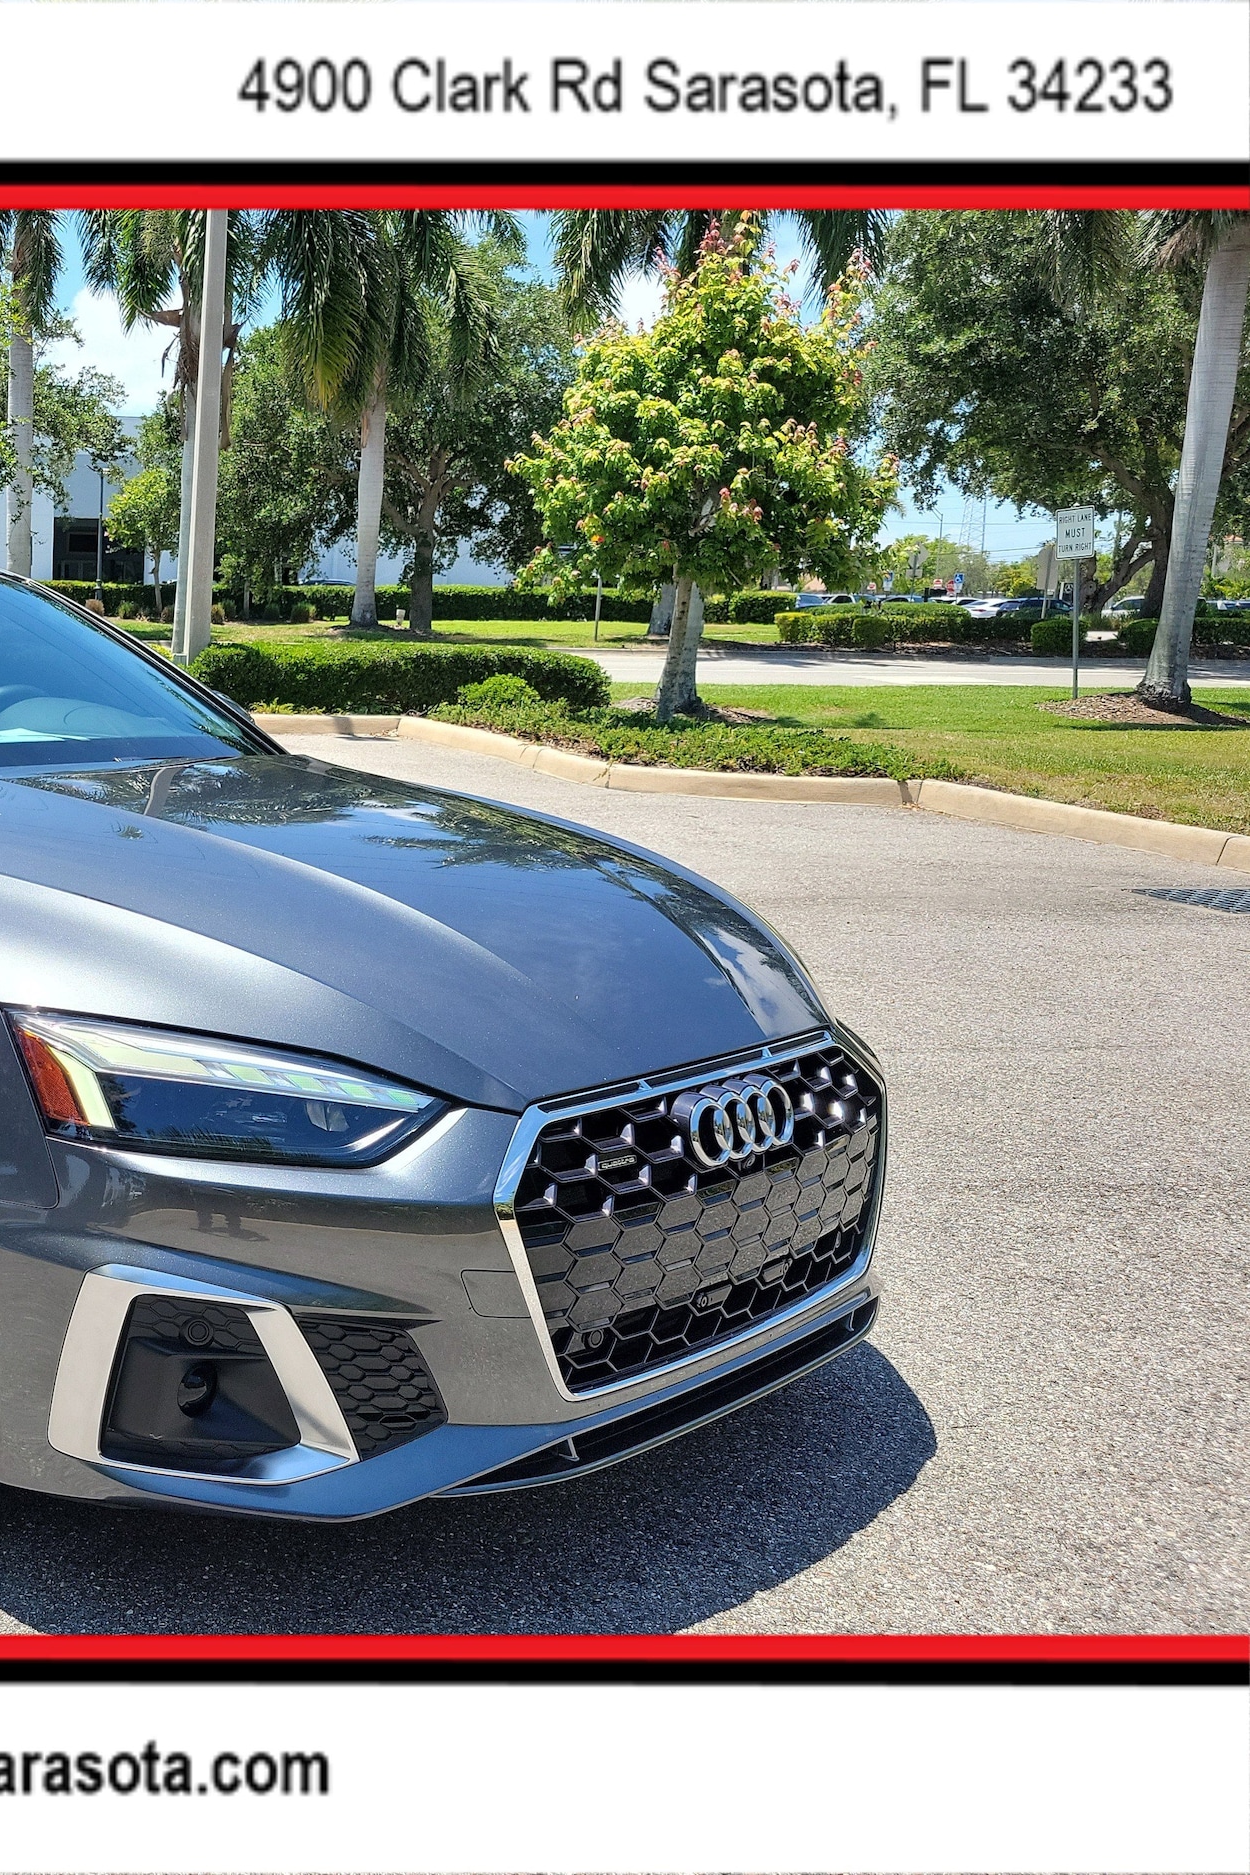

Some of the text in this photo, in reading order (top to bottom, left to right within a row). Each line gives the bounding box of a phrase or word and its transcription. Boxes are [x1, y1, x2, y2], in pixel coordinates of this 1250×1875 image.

[1059, 513, 1092, 524] RIGHT LANE
[1065, 527, 1085, 539] MUST
[1058, 542, 1092, 553] TURN RIGHT
